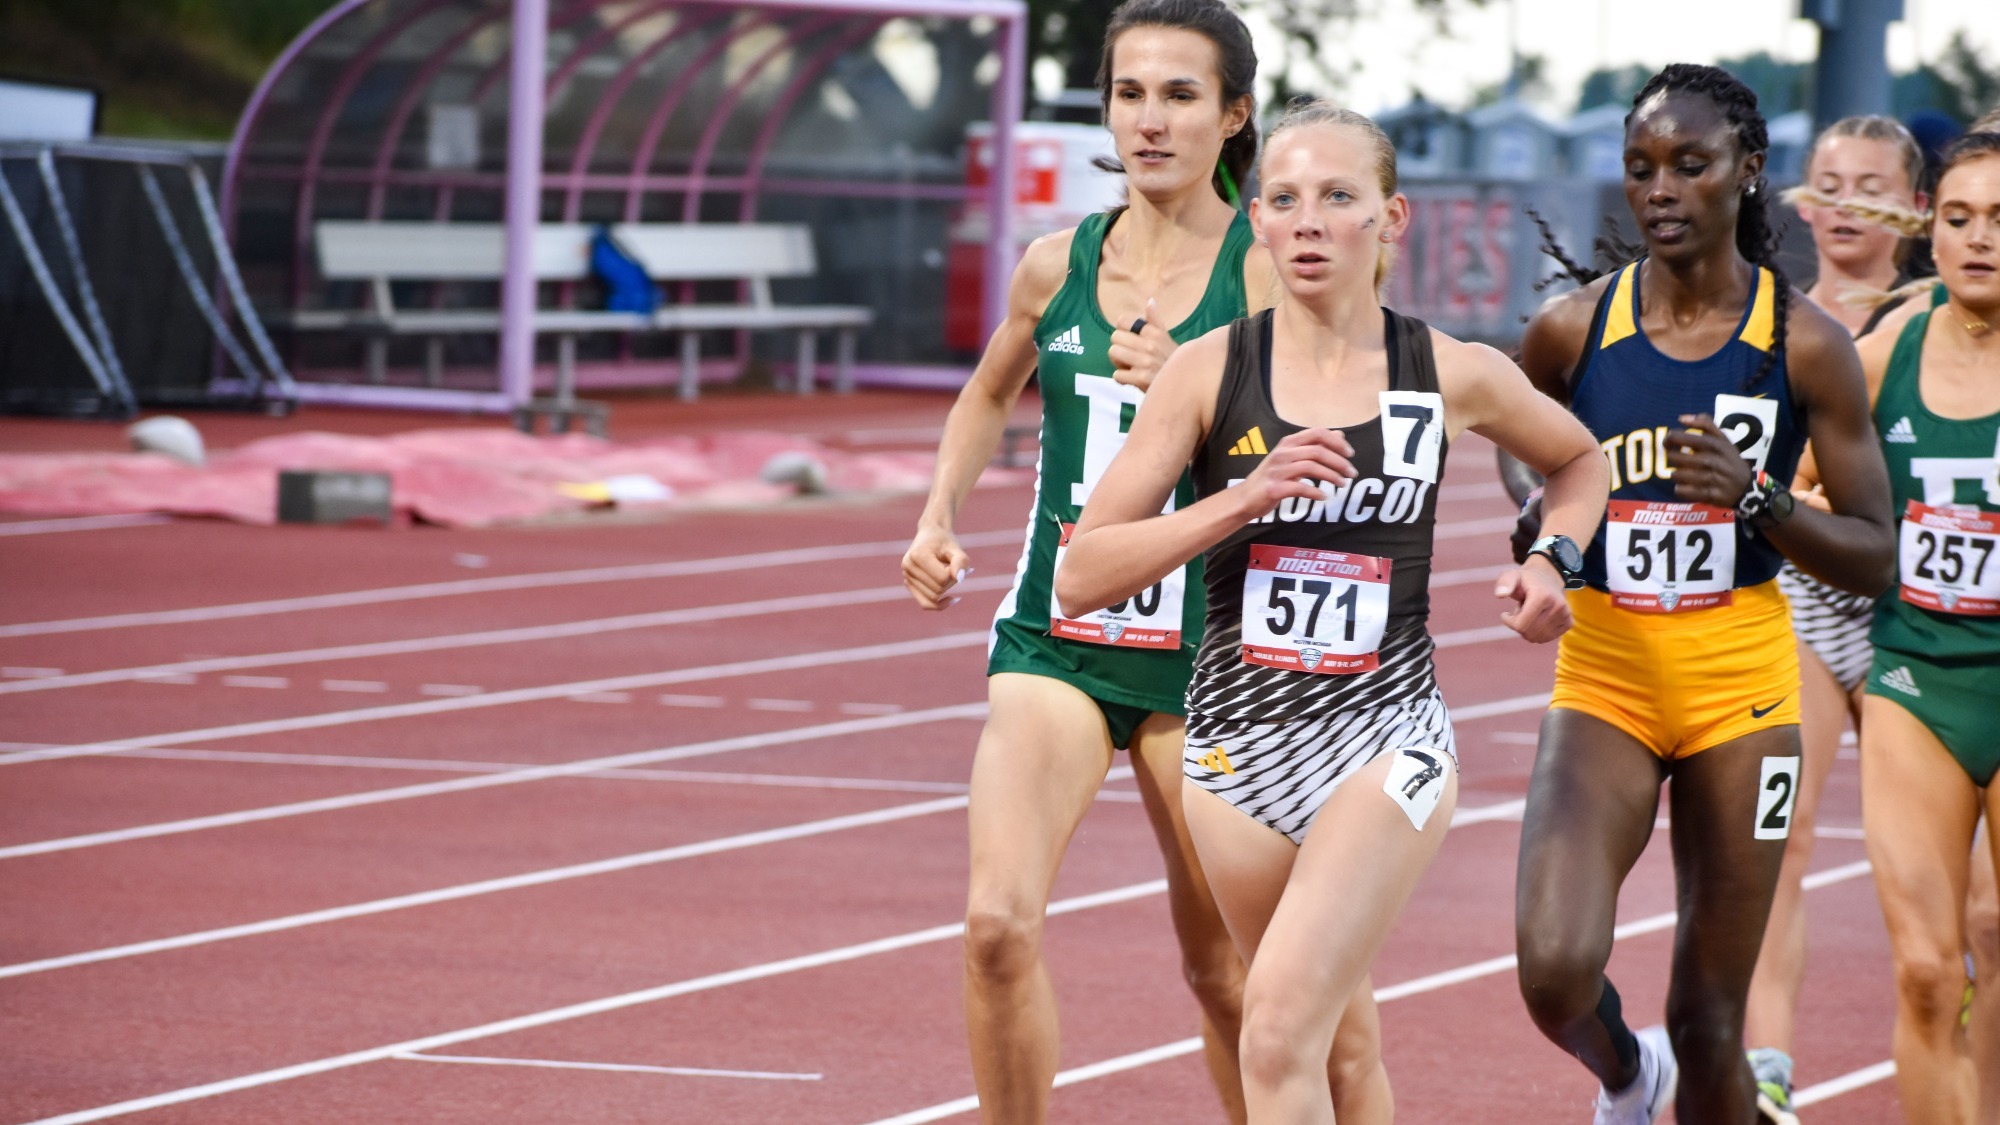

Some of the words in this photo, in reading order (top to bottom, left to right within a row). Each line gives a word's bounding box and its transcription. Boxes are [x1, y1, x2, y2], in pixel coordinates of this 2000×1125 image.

[1048, 341, 1084, 355] adidas
[1389, 404, 1434, 464] 7
[1719, 413, 1763, 470] 2
[1627, 529, 1713, 582] 512
[1915, 530, 1995, 586] 257
[1266, 577, 1358, 641] 571
[1401, 749, 1443, 800] 7
[1760, 772, 1791, 829] 2
